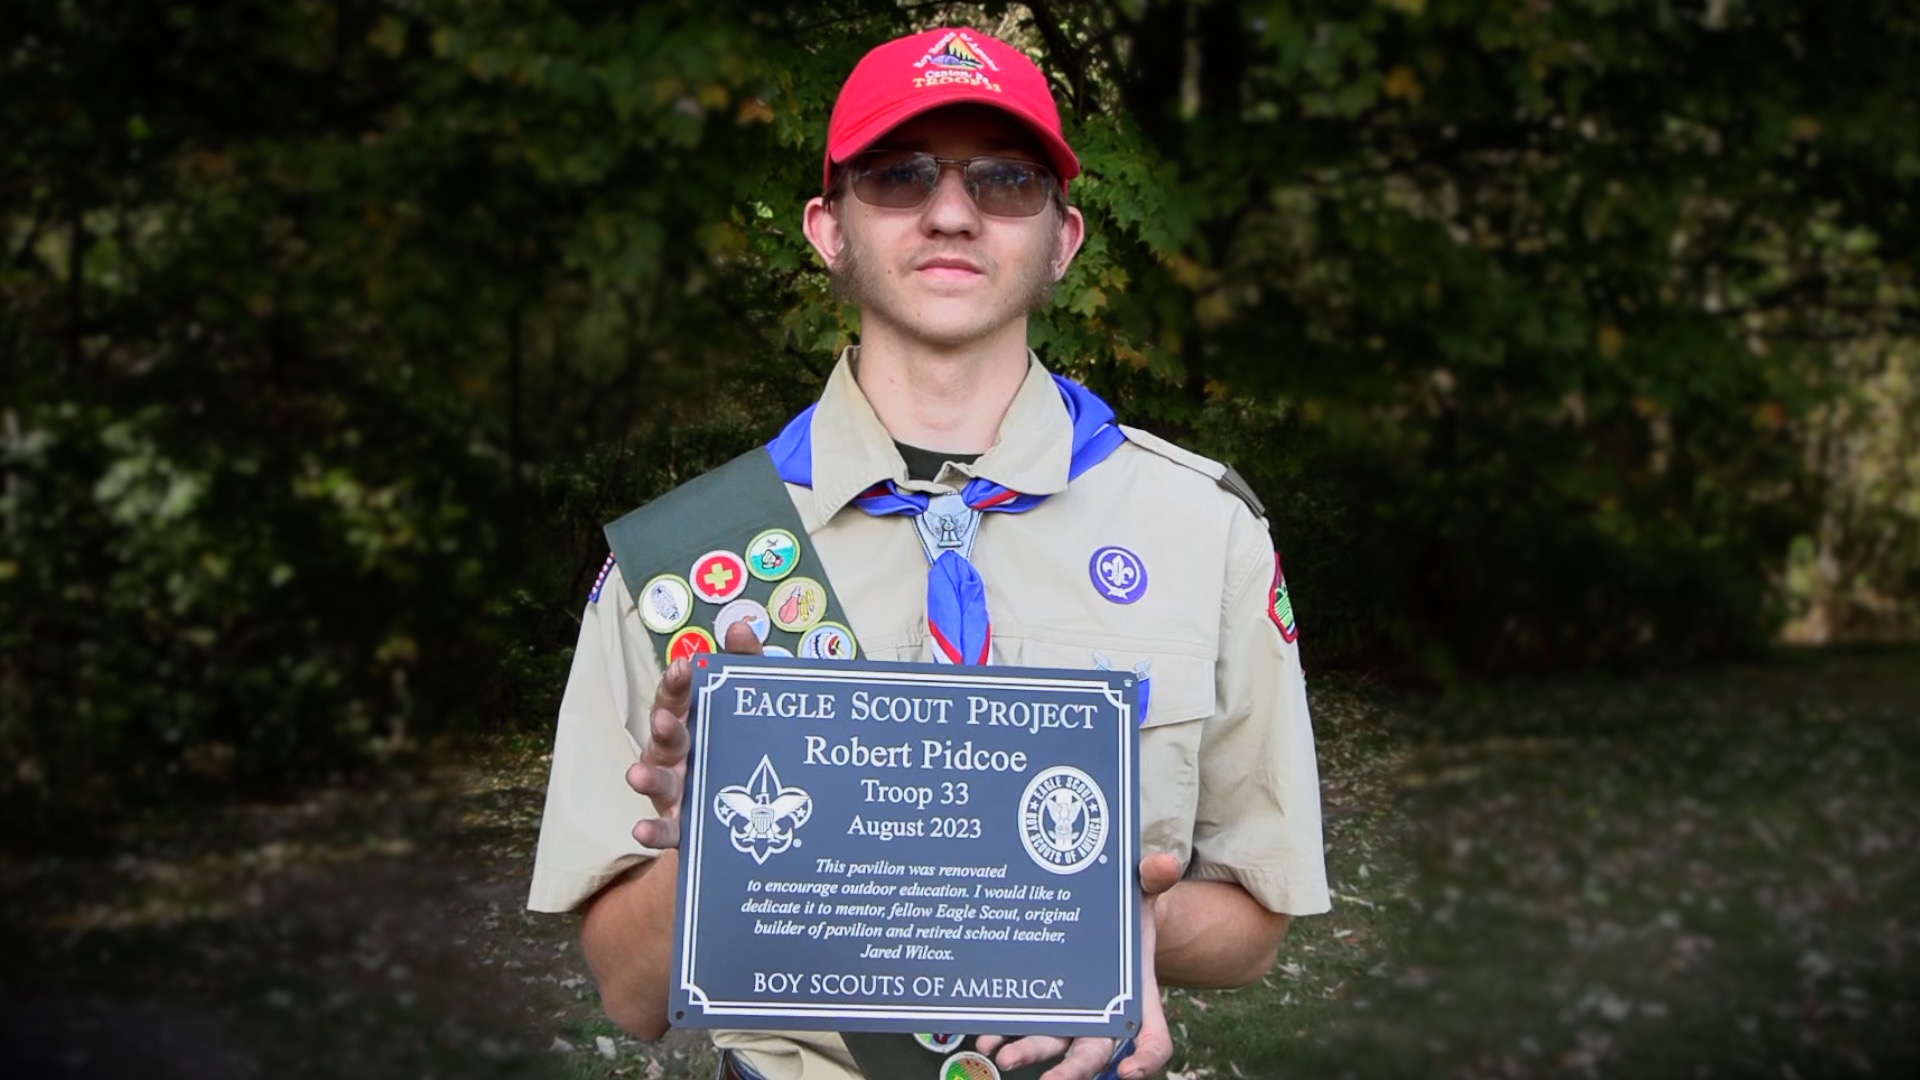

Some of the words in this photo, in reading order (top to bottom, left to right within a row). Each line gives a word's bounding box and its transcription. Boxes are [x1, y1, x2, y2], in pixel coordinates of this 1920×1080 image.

[734, 687, 835, 718] EAGLE
[852, 692, 953, 723] SCOUT
[967, 697, 1098, 734] PROJECT
[804, 736, 912, 768] Robert
[921, 740, 1027, 772] Pidcoe
[861, 779, 932, 809] Troop
[941, 782, 968, 804] 33
[1033, 776, 1062, 800] EAGLE
[1066, 776, 1095, 802] SCOUT
[847, 815, 924, 840] August
[930, 817, 981, 838] 2023
[1030, 833, 1061, 864] SCOUTS
[1065, 852, 1077, 864] OF
[1077, 817, 1101, 858] AMERICA
[817, 859, 844, 873] This
[847, 860, 905, 877] pavilion
[909, 866, 935, 876] was
[939, 865, 1007, 878] renovated
[747, 880, 761, 891] to
[765, 882, 838, 897] encourage
[841, 881, 896, 895] outdoor
[899, 882, 969, 897] education.
[974, 885, 982, 897] I
[984, 885, 1026, 899] would
[1029, 886, 1053, 900] like
[1057, 889, 1071, 900] to
[741, 898, 800, 913] dedicate
[804, 901, 815, 914] it
[818, 903, 831, 914] to
[835, 904, 885, 917] mentor,
[887, 903, 933, 920] fellow
[936, 904, 976, 922] Eagle
[980, 905, 1020, 921] Scout,
[1025, 908, 1080, 924] original
[754, 920, 805, 934] builder
[808, 922, 826, 939] of
[824, 922, 882, 939] pavilion
[887, 925, 913, 938] and
[916, 925, 962, 939] retired
[965, 926, 1008, 940] school
[1013, 927, 1065, 943] teacher,
[860, 944, 902, 958] Jared
[906, 945, 954, 960] Wilcox.
[754, 973, 803, 993] BOY
[810, 974, 904, 995] SCOUTS
[913, 977, 944, 996] OF
